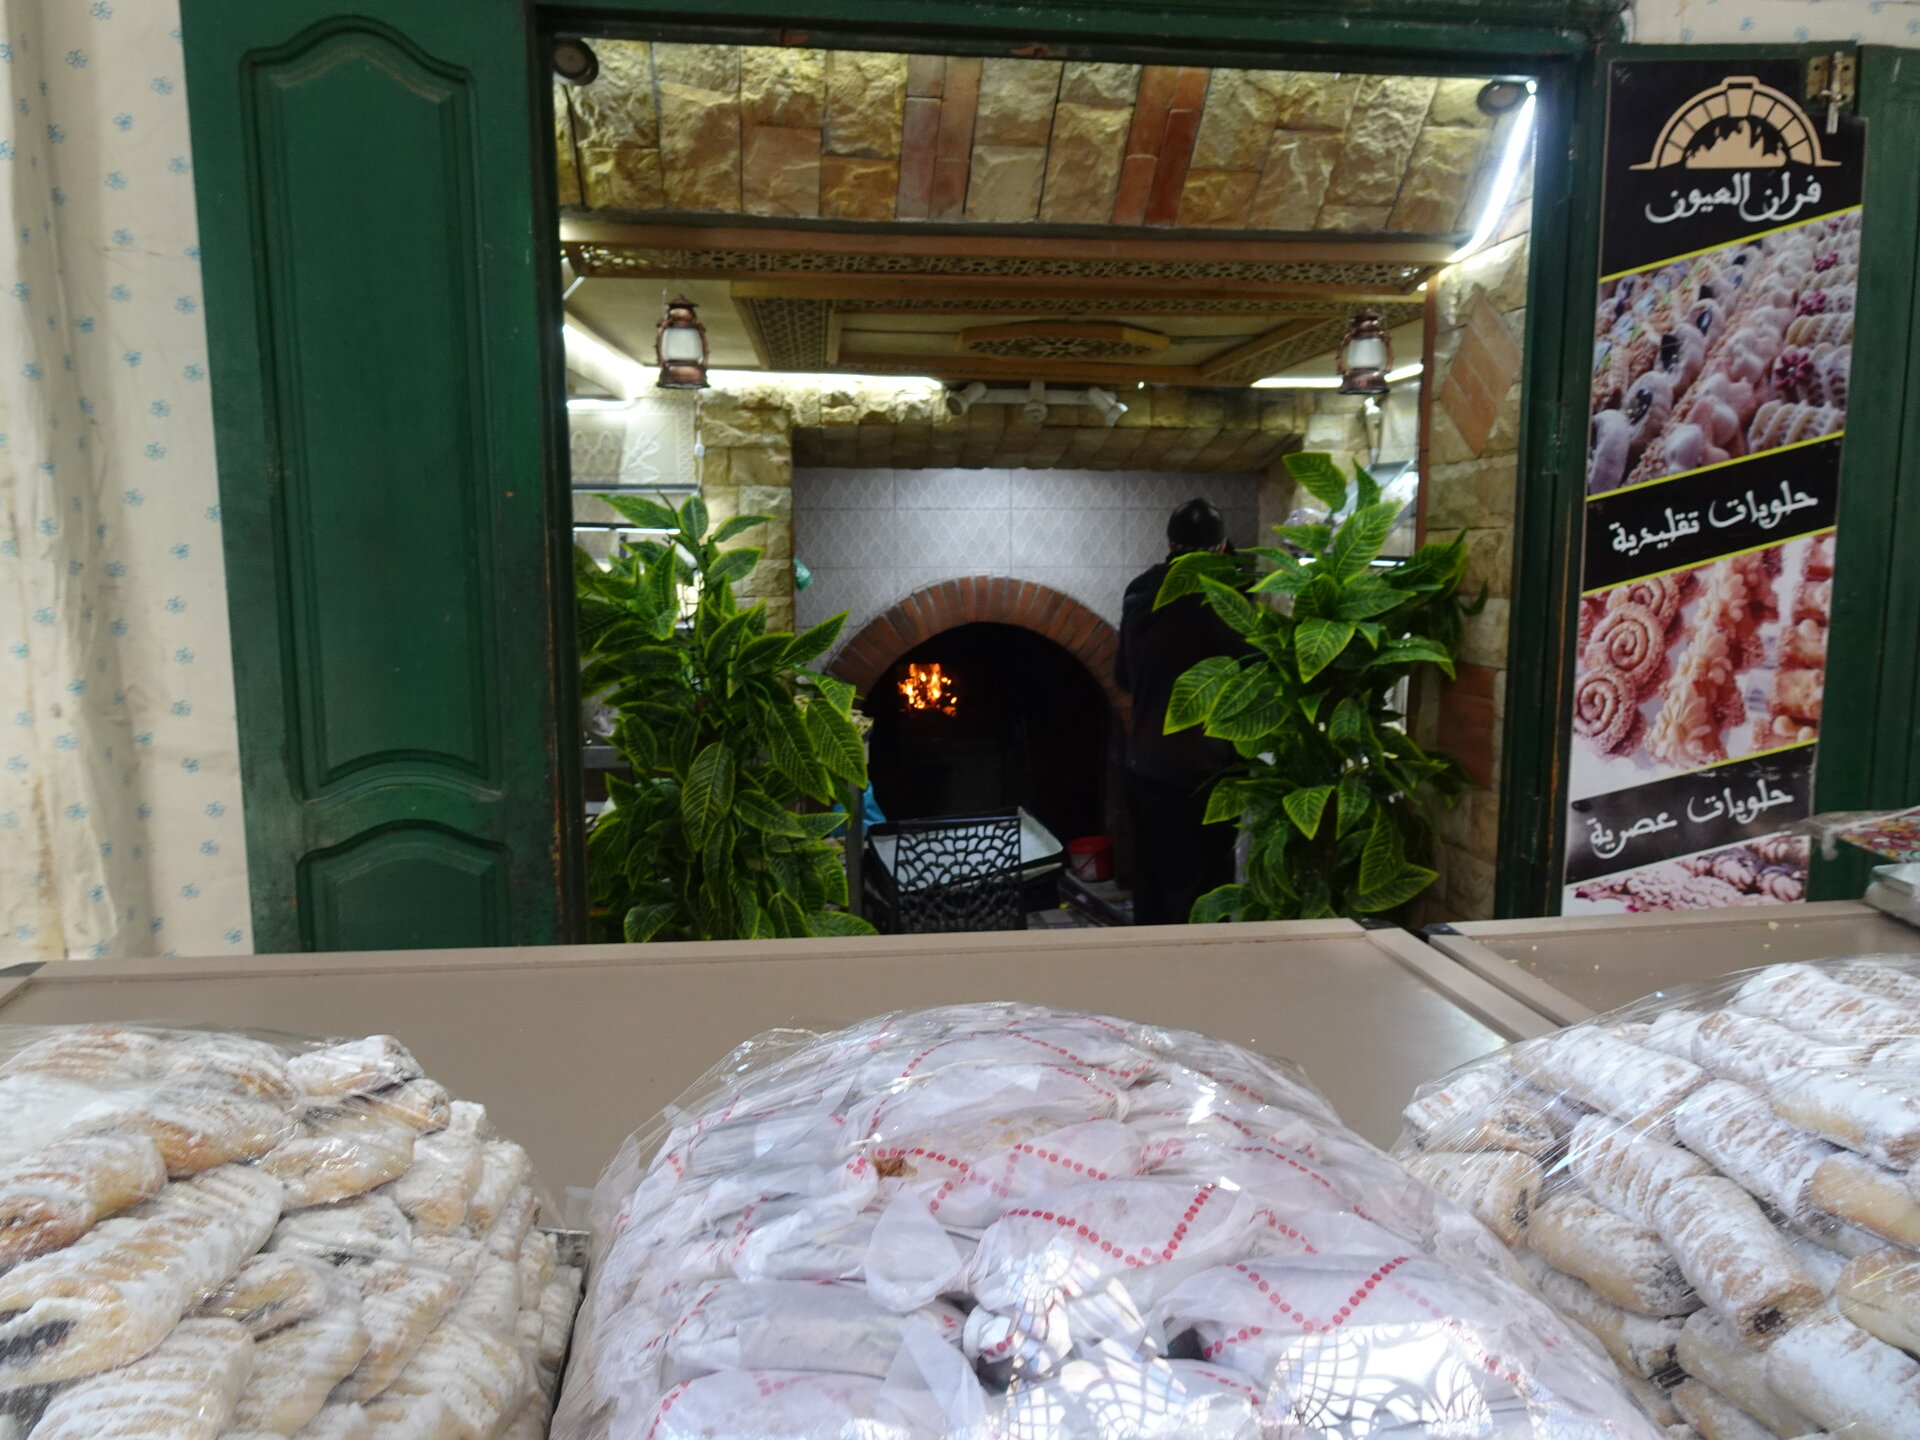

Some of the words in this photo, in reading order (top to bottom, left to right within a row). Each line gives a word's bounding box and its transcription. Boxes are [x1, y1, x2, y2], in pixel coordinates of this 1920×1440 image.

[1645, 171, 1751, 223] العيون
[1739, 171, 1822, 222] فران
[1708, 480, 1819, 529] حلويات
[1609, 507, 1700, 556] تقليدية
[1687, 779, 1794, 825] حلويات
[1586, 811, 1678, 860] عصرية
